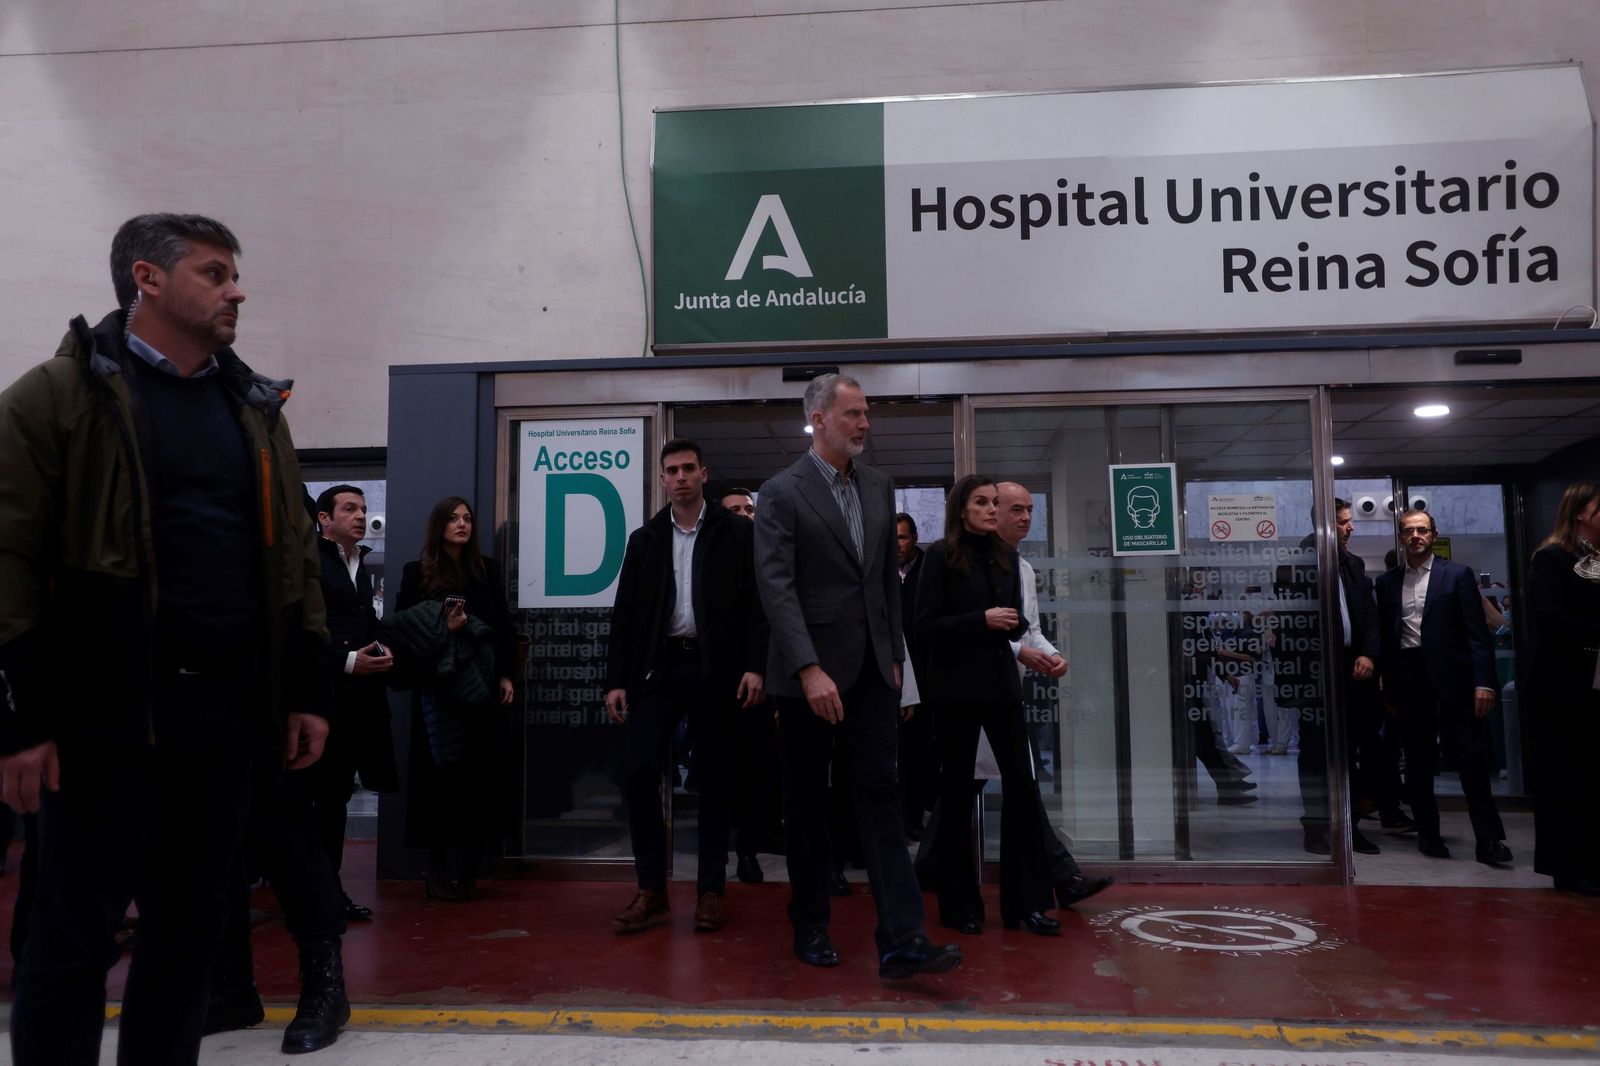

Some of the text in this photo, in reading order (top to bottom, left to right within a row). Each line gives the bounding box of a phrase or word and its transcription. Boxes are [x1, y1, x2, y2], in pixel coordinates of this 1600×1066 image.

[912, 160, 1560, 240] Hospital Universitario
[1222, 226, 1559, 294] Reina Sofía
[674, 283, 866, 310] Junta de Andalucía
[528, 430, 555, 438] Hospital
[556, 429, 597, 437] Universitario
[599, 428, 617, 436] Reina
[533, 445, 630, 471] Acceso
[545, 473, 626, 596] D
[1211, 656, 1300, 683] hosptal
